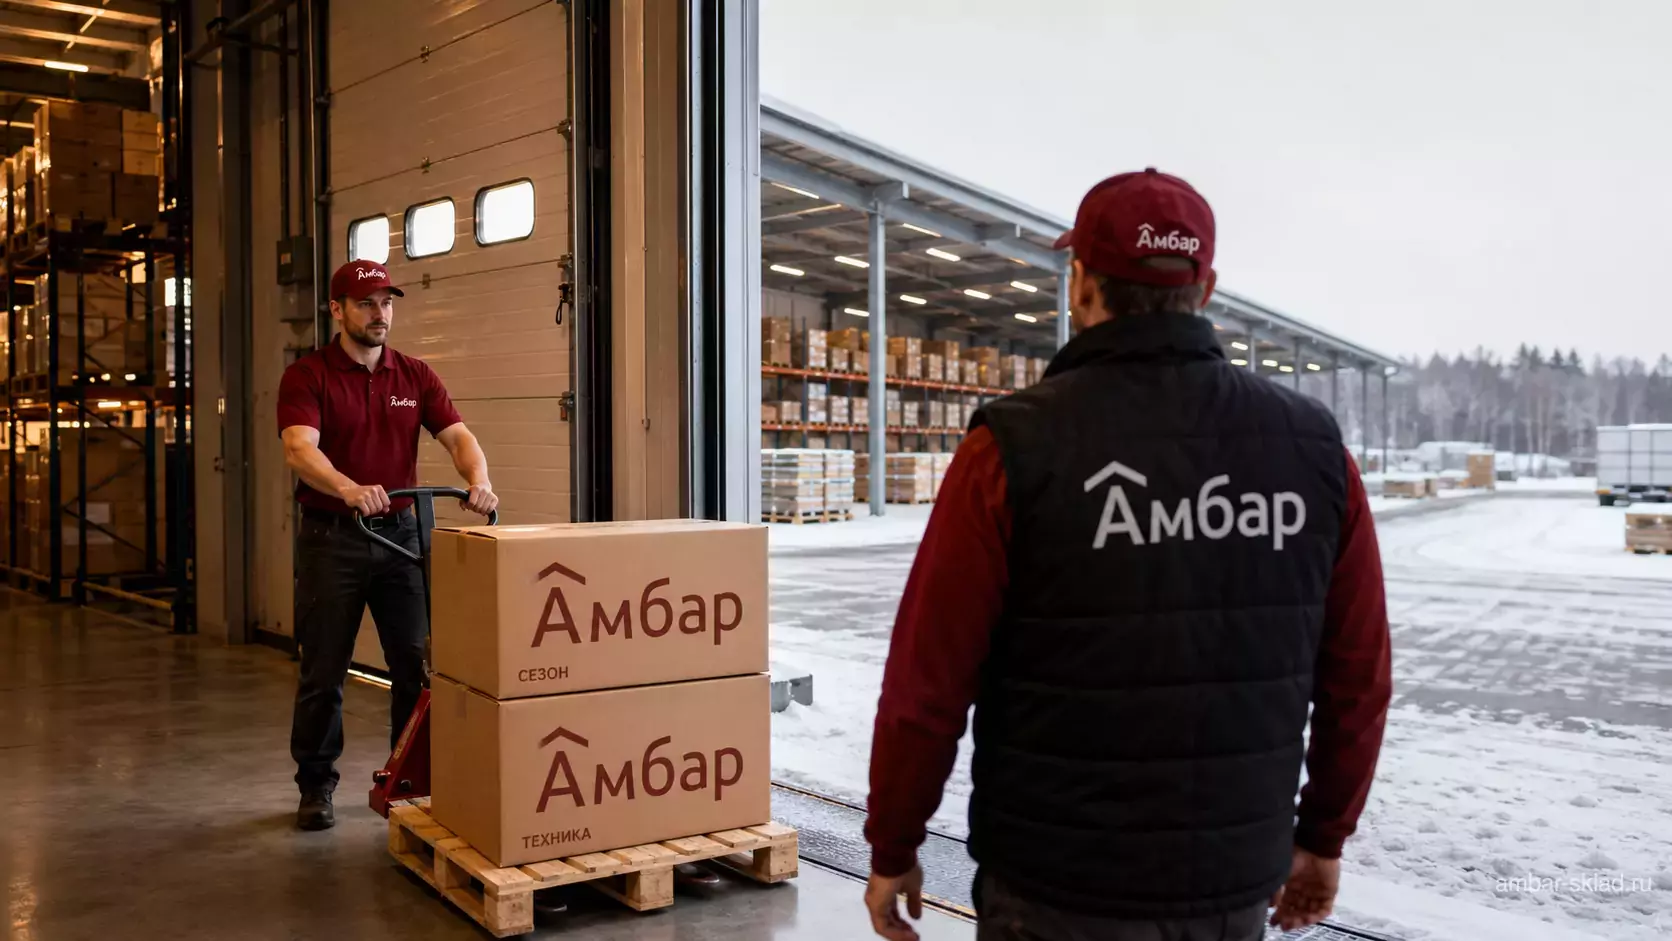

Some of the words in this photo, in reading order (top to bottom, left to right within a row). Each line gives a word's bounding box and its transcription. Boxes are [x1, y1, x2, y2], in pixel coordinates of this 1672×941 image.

[1136, 229, 1200, 255] Амбар
[1093, 474, 1306, 551] Амбар
[530, 577, 744, 648] Амбар
[518, 665, 569, 682] СЕЗОН
[535, 735, 744, 813] Амбар
[522, 828, 592, 849] ТЕХНИКА
